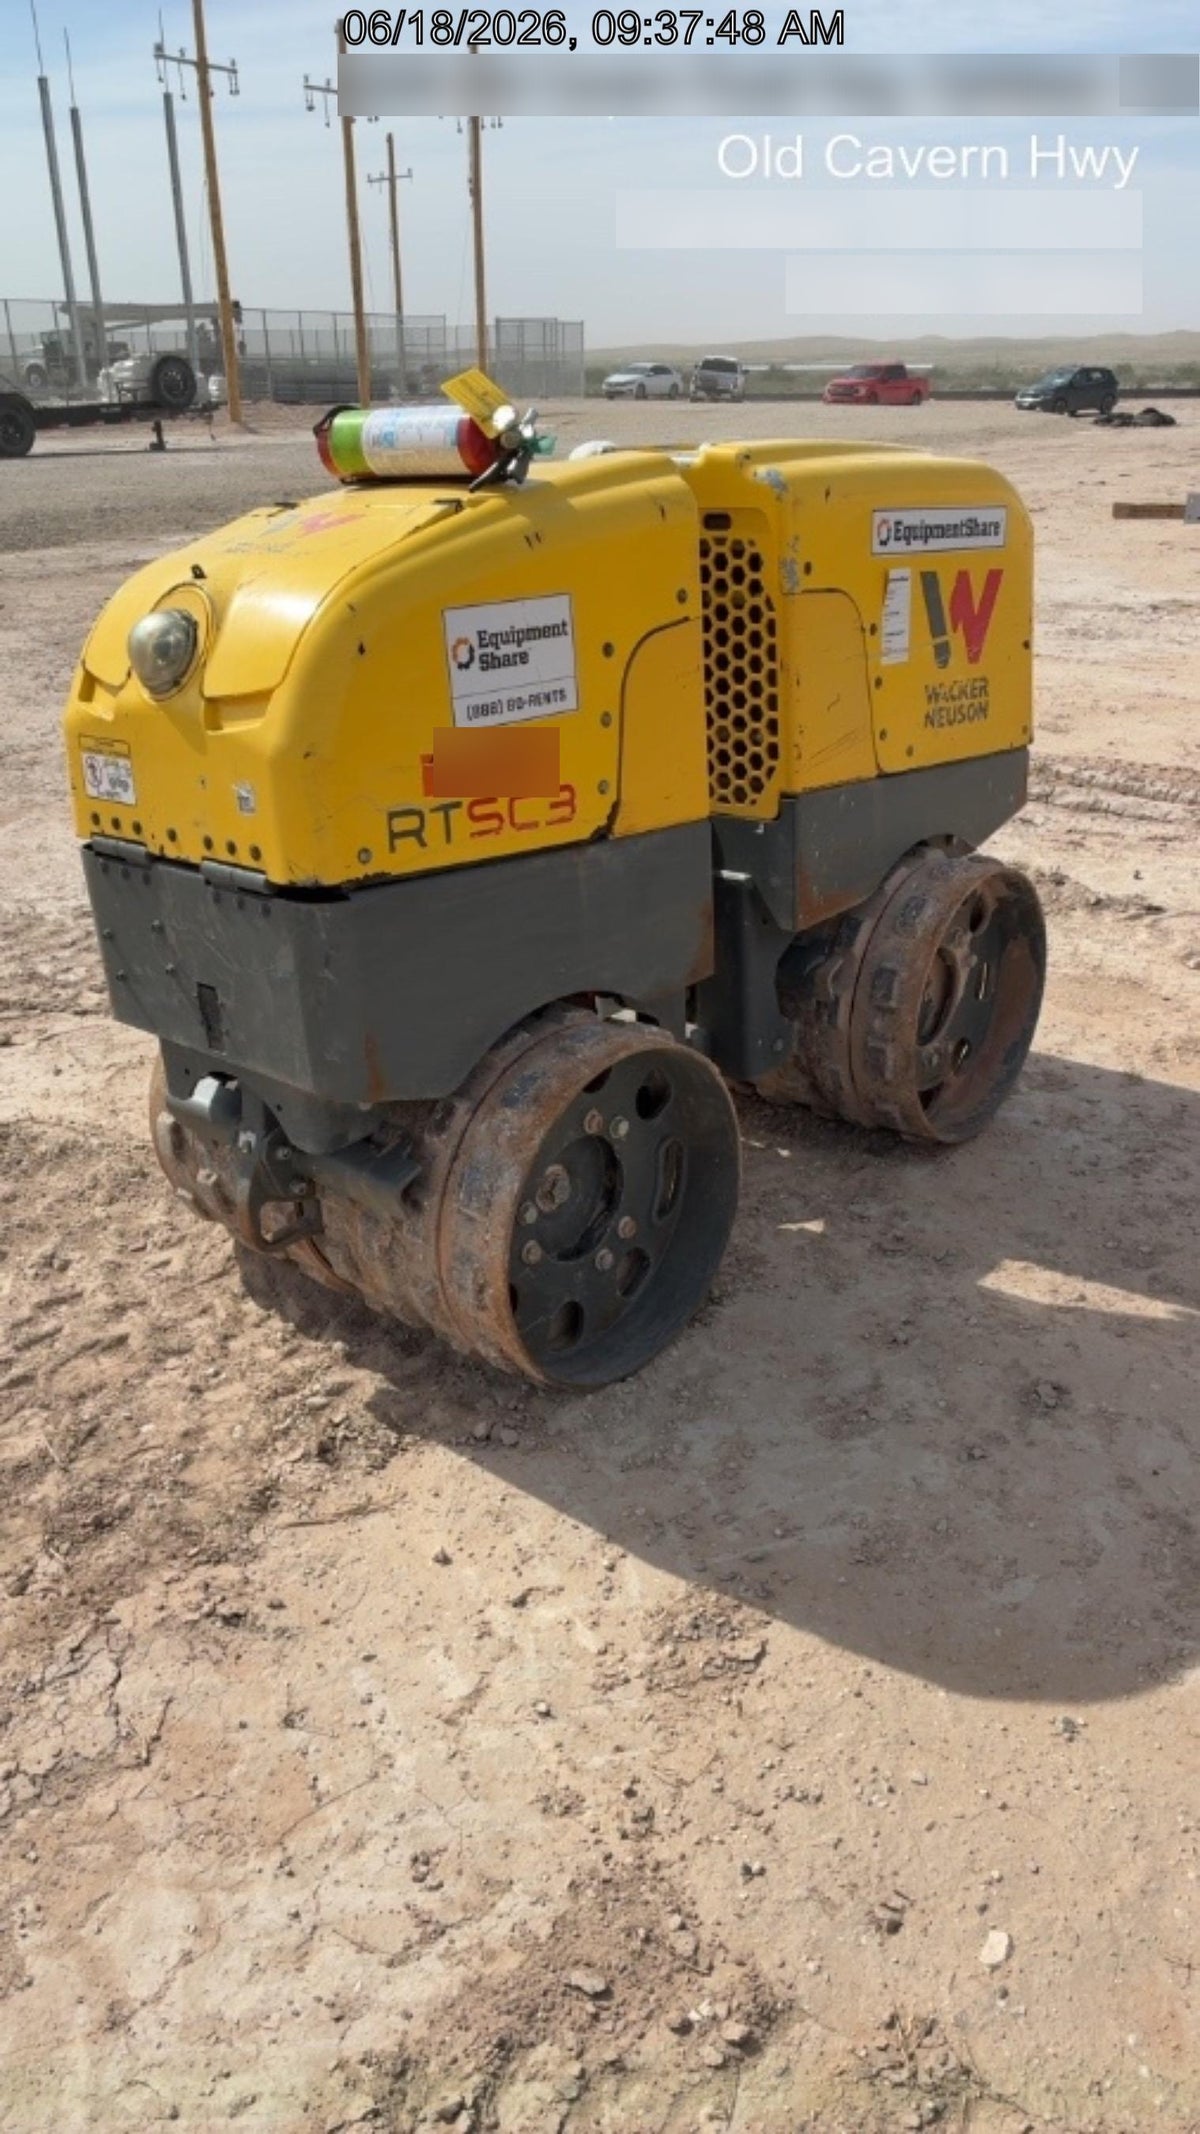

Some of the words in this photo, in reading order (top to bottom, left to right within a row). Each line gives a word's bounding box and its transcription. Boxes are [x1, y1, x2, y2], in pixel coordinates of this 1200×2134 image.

[893, 515, 1001, 545] EquipmentShare
[476, 619, 568, 650] Equipment
[478, 650, 530, 672] Share
[924, 699, 990, 729] NEUSON
